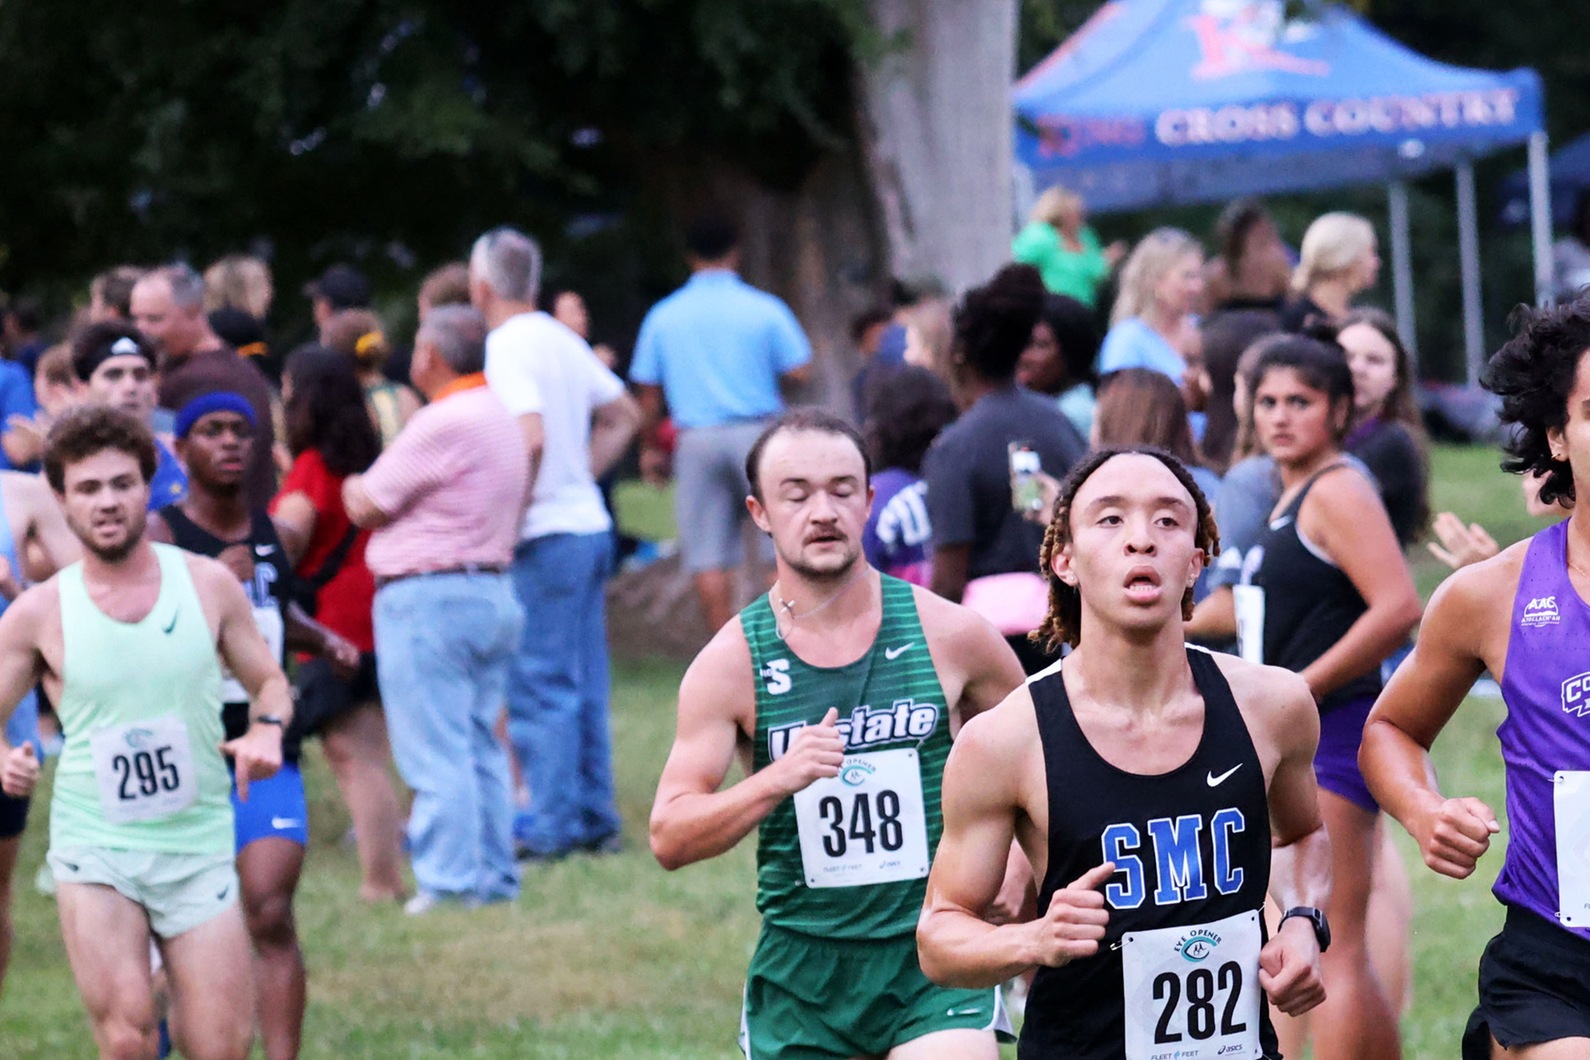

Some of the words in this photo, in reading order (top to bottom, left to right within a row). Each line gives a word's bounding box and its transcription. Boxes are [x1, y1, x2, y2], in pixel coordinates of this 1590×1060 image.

[1528, 596, 1556, 610] AAC
[766, 658, 792, 695] S
[112, 745, 180, 800] 295
[818, 790, 904, 858] 348
[1101, 807, 1245, 909] SMC
[1174, 936, 1187, 952] EYE
[1190, 929, 1222, 944] OPENER
[1152, 961, 1247, 1045] 282
[1151, 1053, 1172, 1060] FLEET
[1181, 1050, 1199, 1058] FEET
